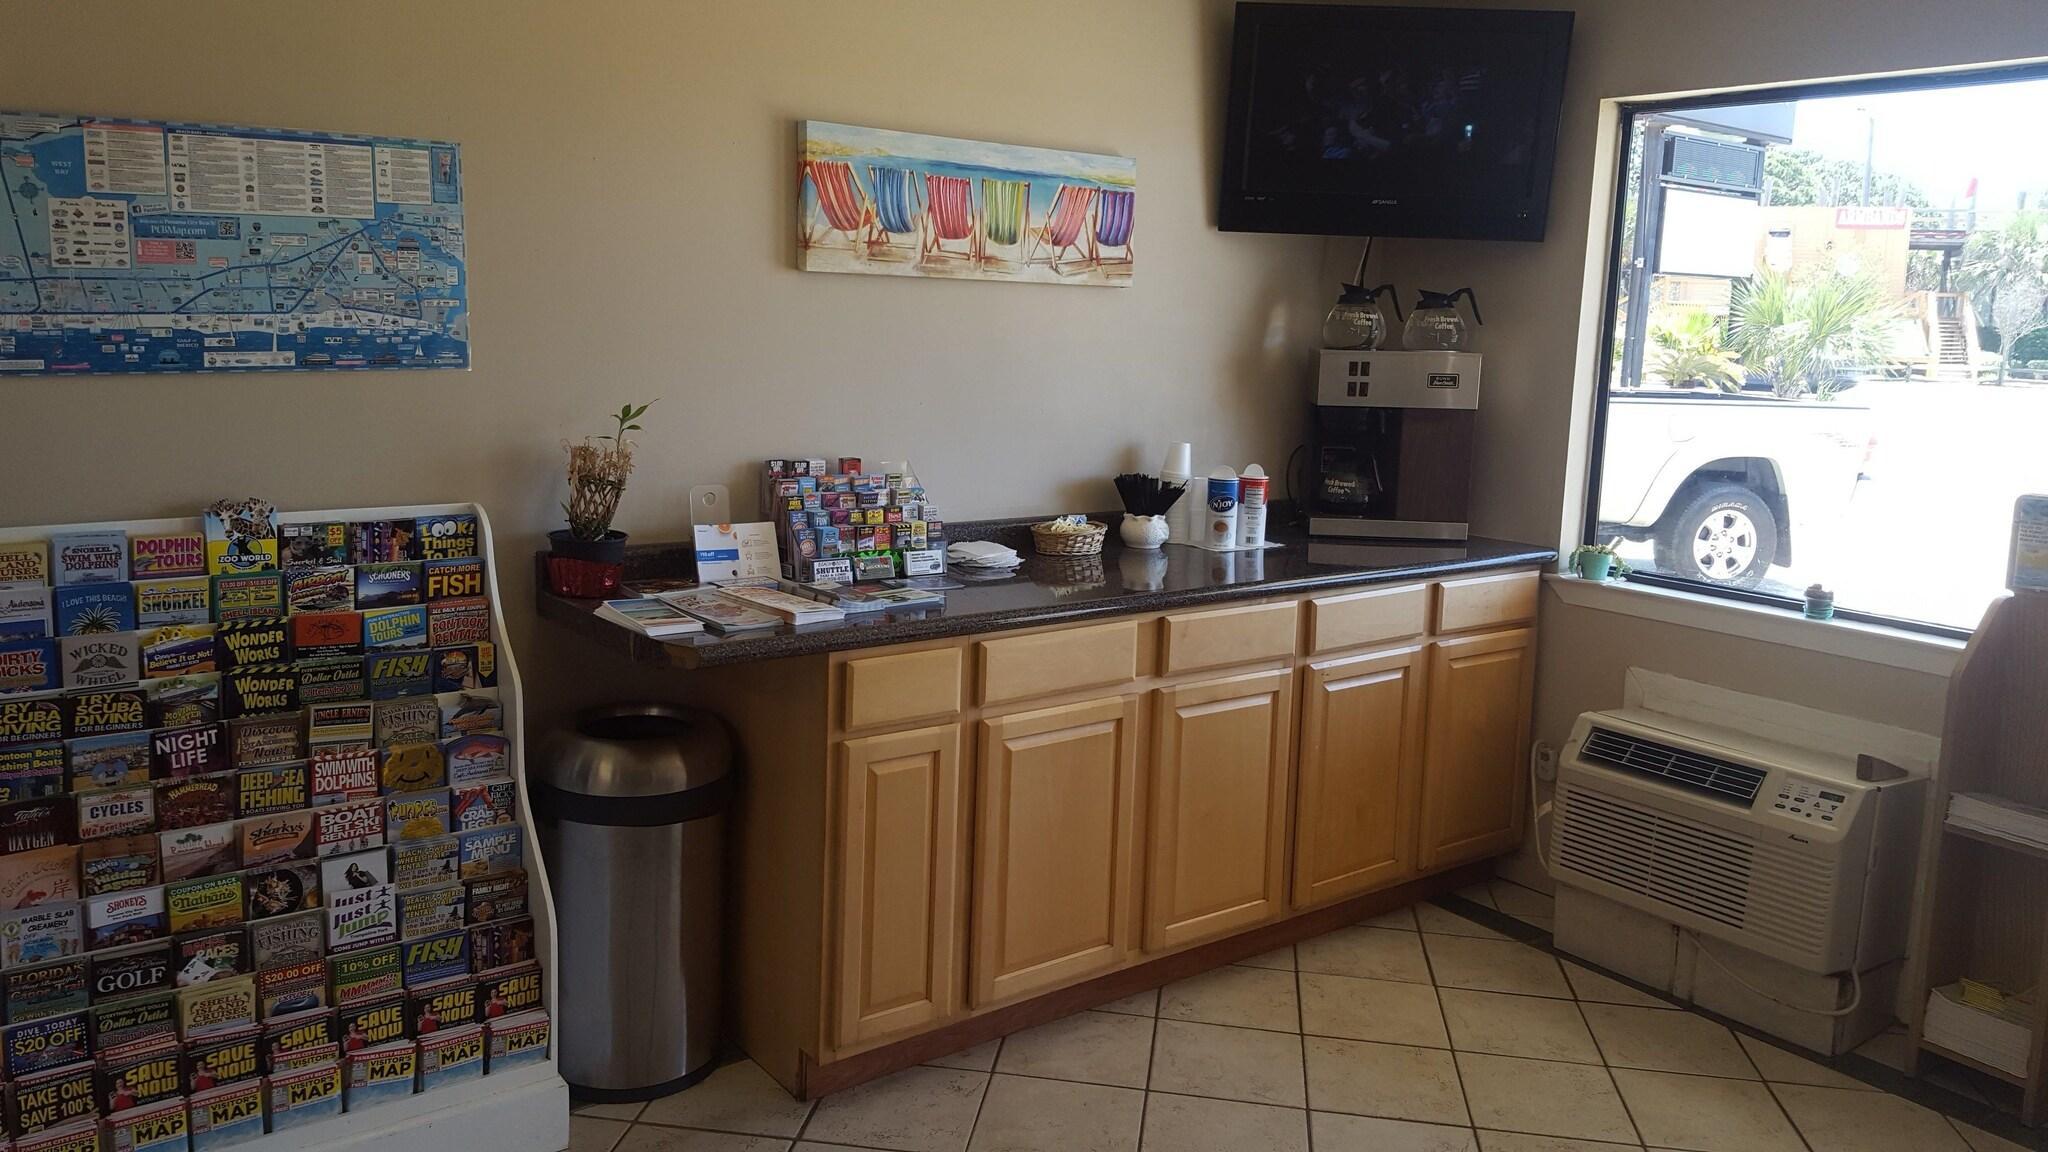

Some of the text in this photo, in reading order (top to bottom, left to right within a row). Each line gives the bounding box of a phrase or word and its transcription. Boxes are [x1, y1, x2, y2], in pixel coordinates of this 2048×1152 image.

[1353, 318, 1373, 327] Coffee
[1434, 322, 1453, 330] Coffee
[1327, 486, 1345, 494] Coffee
[72, 546, 112, 554] SNORKEL
[136, 537, 202, 554] DOLPHIN
[421, 536, 475, 551] Things
[62, 552, 122, 563] SWIM WITH
[155, 553, 203, 568] TOURS
[219, 553, 272, 564] ZOO WORLD
[422, 548, 473, 560] To Do!
[65, 559, 119, 571] DOLPHINS
[428, 563, 481, 575] CATCH MORE
[815, 566, 849, 575] SHUTTLE
[368, 569, 411, 583] SCHOONERS
[427, 573, 482, 598] FISH
[66, 595, 102, 607] LOVE THIS
[142, 593, 207, 612] SNORKEL
[221, 608, 280, 619] SHELL ISLAND
[369, 613, 421, 633] DOLPHIN
[432, 617, 485, 632] PONTOON
[223, 630, 285, 650] WONDER
[369, 628, 404, 643] TOURS
[69, 643, 128, 659] WICKED
[149, 659, 178, 670] Believe
[179, 655, 186, 663] It
[197, 649, 214, 659] Not!
[234, 646, 280, 665] WORKS
[302, 669, 360, 684] Dollar Outlet
[372, 655, 430, 680] FISH
[75, 672, 126, 686] WHEEL
[235, 676, 295, 694] WONDER
[79, 693, 117, 705] TRY
[243, 693, 289, 710] WORKS
[76, 701, 143, 716] SCUBA
[314, 708, 339, 721] UNCLE
[74, 711, 144, 727] DIVING
[381, 709, 438, 727] FISHING
[11, 732, 62, 742] BEGINNERS
[75, 722, 144, 735] FOR BEGINNERS
[155, 729, 218, 755] NIGHT
[35, 748, 63, 758] Boats
[171, 748, 208, 769] LIFE
[33, 758, 63, 768] Boats
[315, 756, 375, 778] SWIM WITH
[240, 768, 305, 790] DEEP SEA
[316, 772, 376, 793] DOLPHINS!
[168, 783, 219, 800] HAMMERHEAD
[240, 787, 305, 810] FISHING
[90, 801, 144, 819] CYCLES
[320, 806, 380, 828] BOAT
[461, 810, 494, 822] CRAB
[356, 815, 380, 829] SKI
[462, 819, 494, 831] LEGS
[81, 827, 97, 839] We
[320, 824, 381, 843] RENTALS
[465, 833, 517, 851] SAMPLE
[471, 844, 511, 861] MENU
[170, 877, 237, 896] COUPON ON BACK
[21, 909, 74, 925] MARBLE SLAB
[27, 919, 69, 933] CREAMERY
[333, 904, 371, 930] Just
[258, 926, 320, 948] FISHING
[333, 934, 394, 954] COME JUMP WITH US
[406, 936, 464, 967] FISH
[342, 953, 396, 973] 10% OFF
[10, 962, 85, 984] FLORIDA'S
[97, 967, 166, 993] GOLF
[265, 964, 321, 985] $20.00 OFF
[498, 975, 540, 997] SAVE
[199, 996, 242, 1010] SHELL
[433, 989, 477, 1013] SAVE
[507, 988, 540, 1009] NOW
[192, 1007, 248, 1024] CRUISES
[196, 1000, 247, 1017] ISLAND
[441, 1005, 476, 1024] NOW
[17, 1017, 78, 1038] DIVE TODAY
[99, 1008, 168, 1034] Dollar Outlet
[356, 1007, 403, 1031] SAVE
[279, 1022, 329, 1049] SAVE
[368, 1021, 404, 1043] NOW
[508, 1026, 548, 1041] VISITOR'S
[15, 1028, 81, 1057] $20 OFF
[440, 1037, 481, 1055] VISITOR'S
[508, 1033, 547, 1051] MAP
[206, 1043, 257, 1069] SAVE
[292, 1053, 337, 1067] VISITOR'S
[370, 1055, 412, 1067] VISITOR'S
[441, 1044, 481, 1065] MAP
[125, 1060, 178, 1087] SAVE
[217, 1057, 257, 1080] NOW
[370, 1062, 411, 1081] MAP
[137, 1076, 180, 1099] NOW
[290, 1075, 335, 1090] VISITOR'S
[17, 1077, 94, 1112] TAKE ONE
[210, 1094, 258, 1110] VISITOR'S
[291, 1083, 334, 1104] MAP
[20, 1105, 59, 1129] SAVE
[134, 1112, 184, 1131] VISITOR'S
[212, 1102, 258, 1125] MAP
[135, 1120, 184, 1144] MAP
